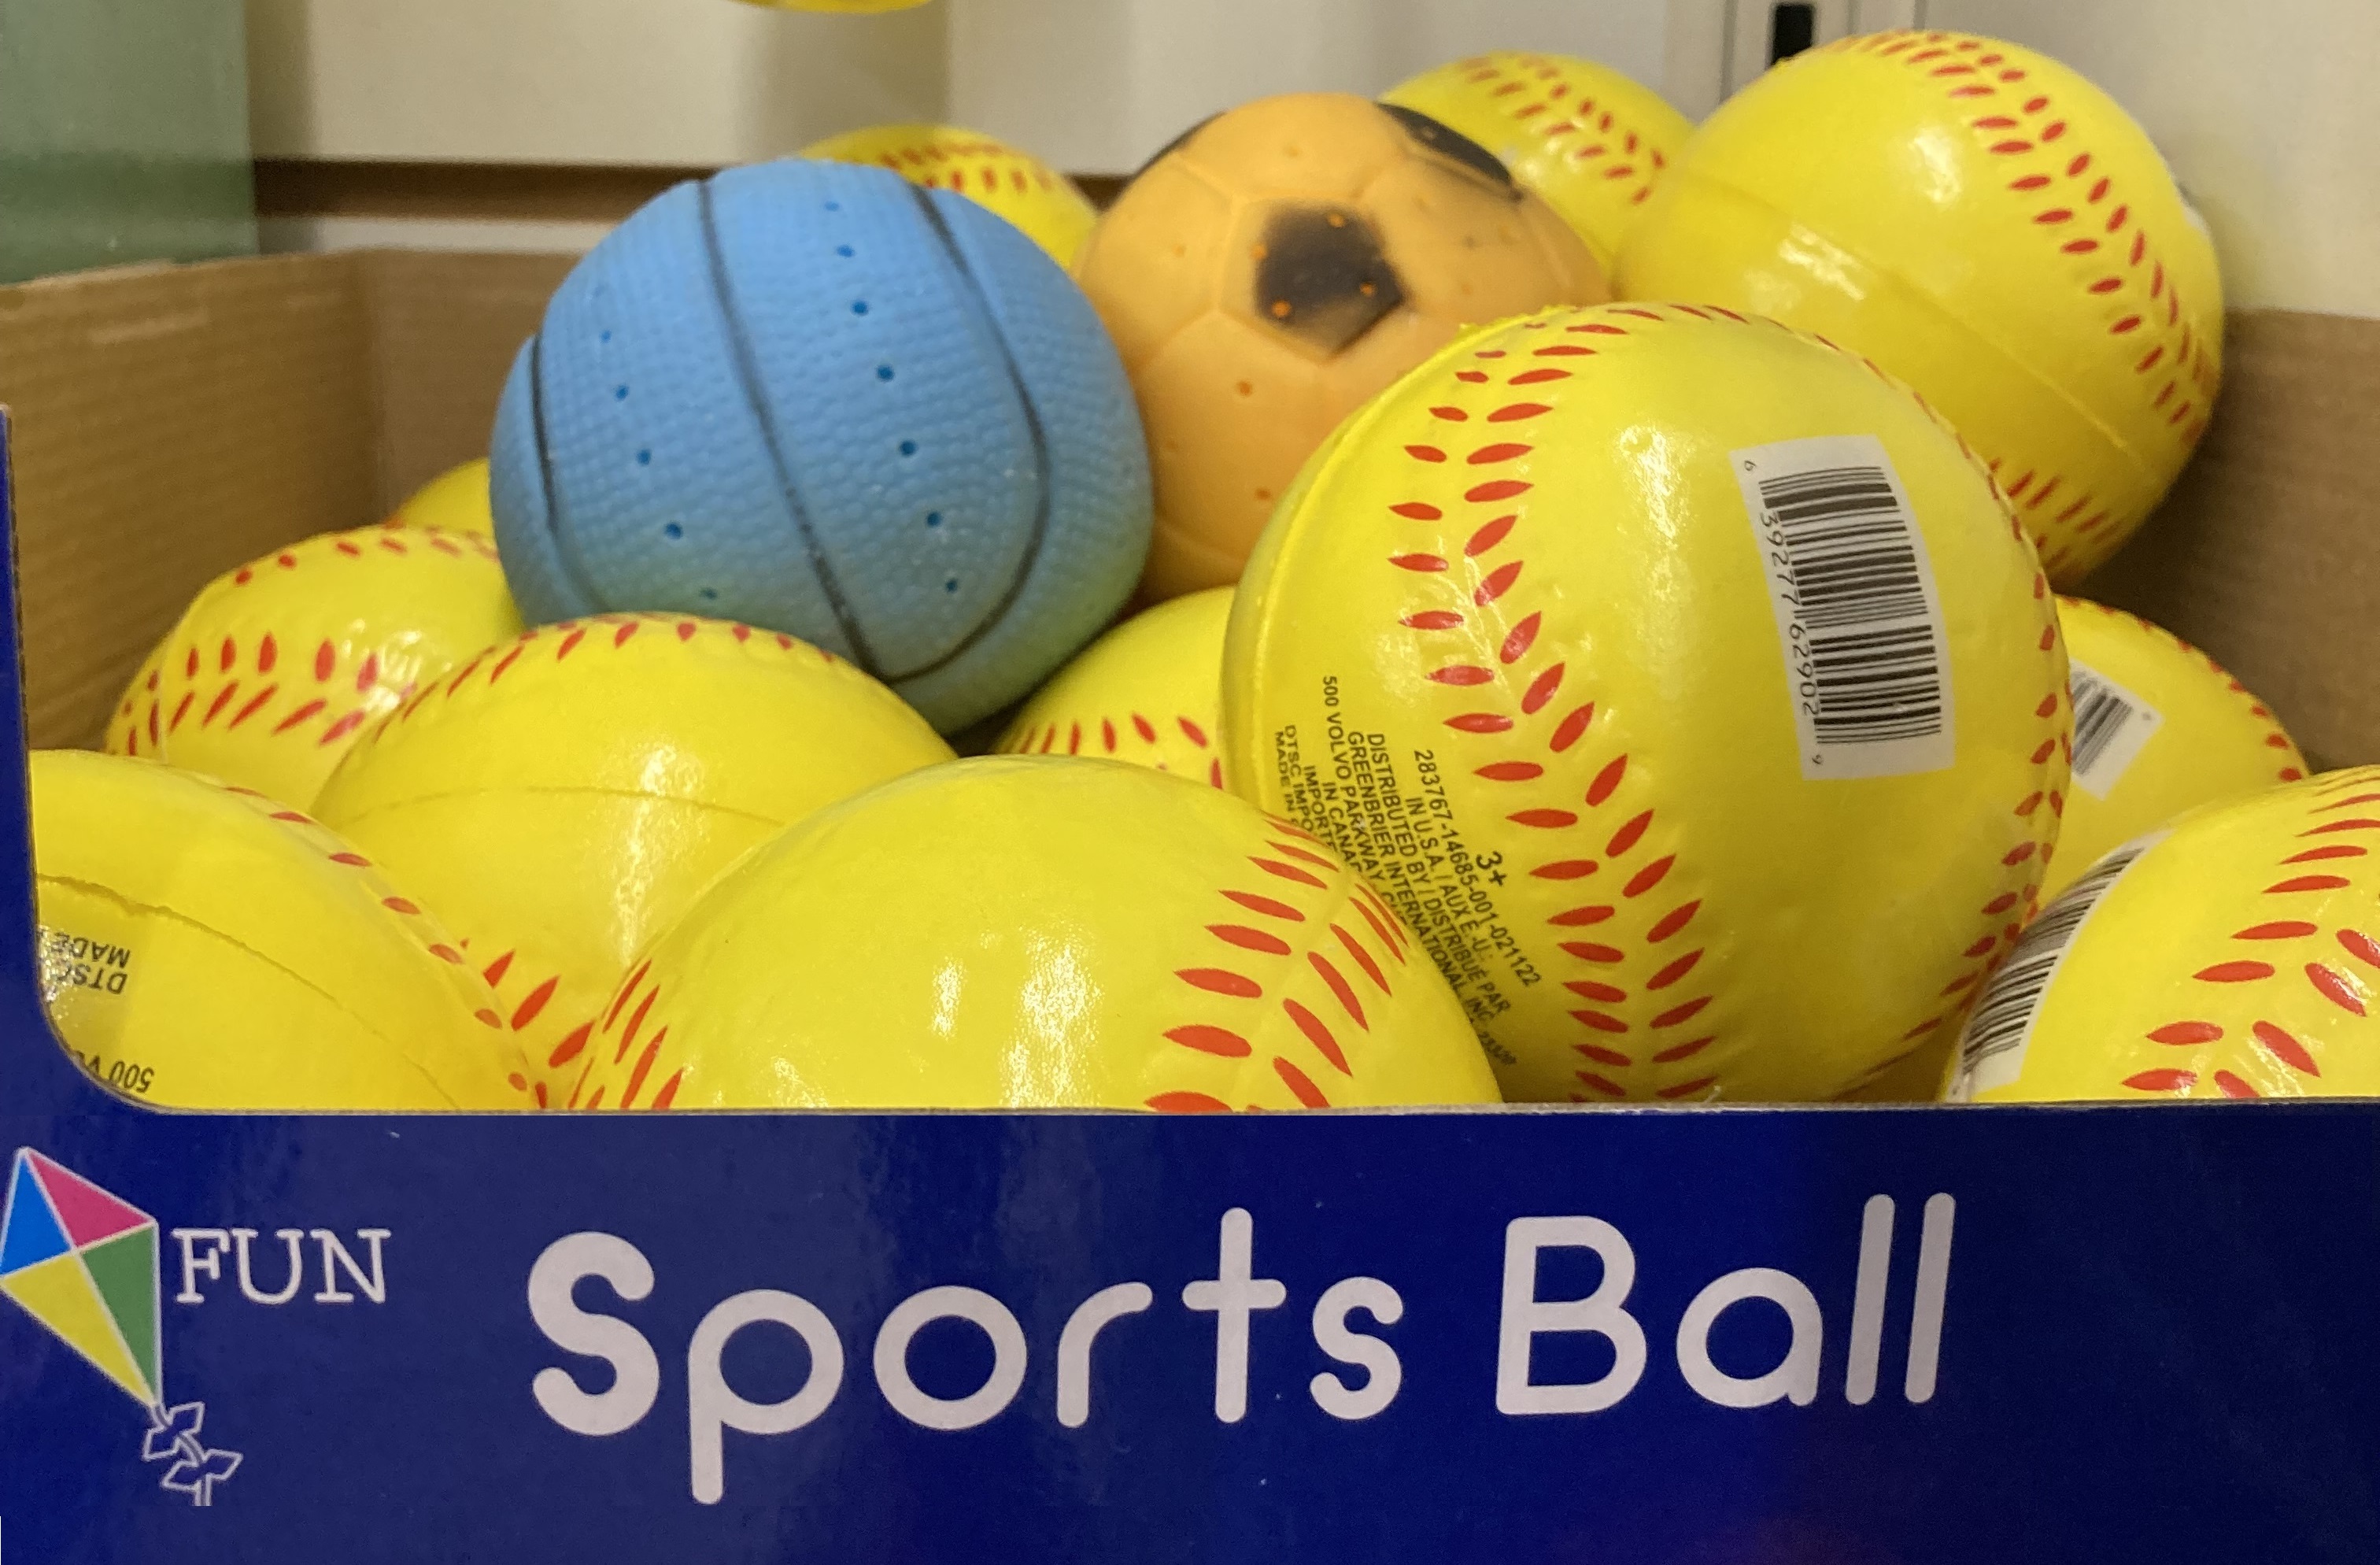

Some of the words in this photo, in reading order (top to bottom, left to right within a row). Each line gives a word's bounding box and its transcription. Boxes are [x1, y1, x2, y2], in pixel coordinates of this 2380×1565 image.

[1759, 511, 1800, 606] 39277
[1788, 622, 1822, 717] 62902
[1322, 675, 1340, 707] 500
[1274, 731, 1292, 787] MADE
[1284, 793, 1297, 812] IN
[1284, 724, 1302, 777] DTSC
[1293, 783, 1314, 833] IMPO
[1326, 712, 1352, 779] VOLVO
[1322, 782, 1340, 801] IN
[1340, 786, 1386, 881] PARKWAY
[1347, 731, 1396, 858] GREENBRIER
[1366, 733, 1417, 857] DISTRIBUTED
[1406, 861, 1432, 884] BY
[1476, 982, 1511, 1015] PAR
[1405, 797, 1427, 816] IN
[1439, 885, 1472, 919] AUX
[1476, 851, 1507, 886] 3+
[109, 1060, 154, 1093] 500
[172, 1226, 392, 1304] FUN
[527, 1207, 1404, 1505] Sports
[1496, 1193, 1955, 1416] Ball
